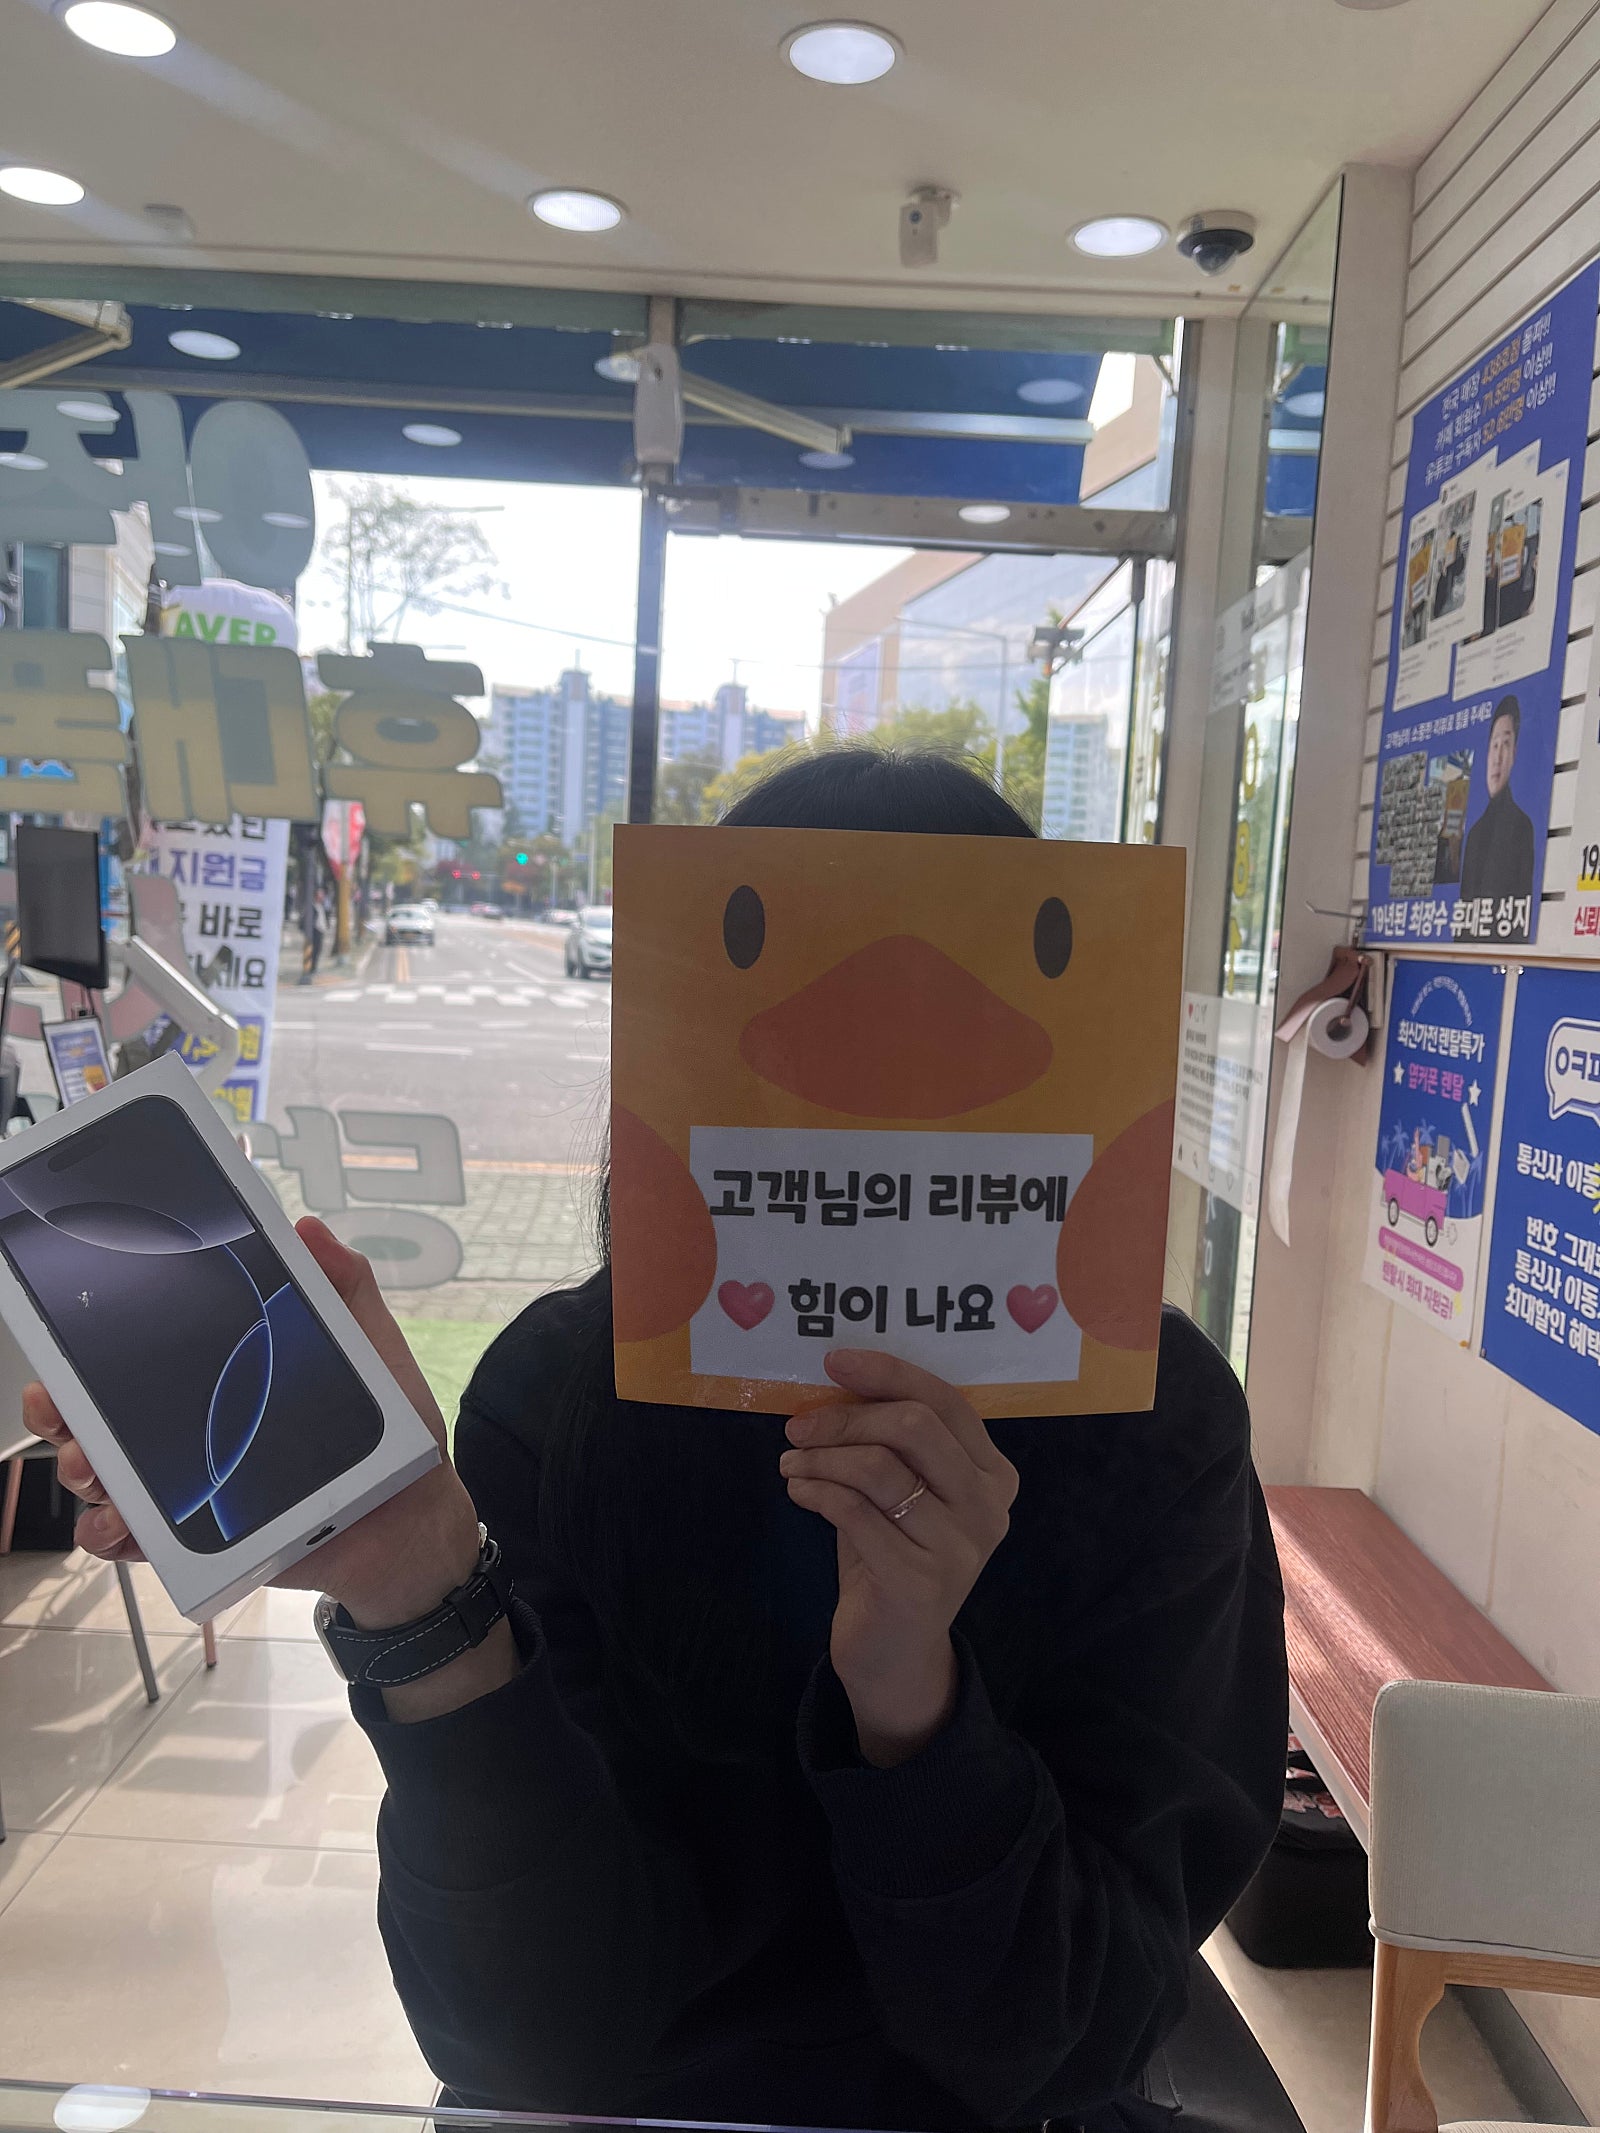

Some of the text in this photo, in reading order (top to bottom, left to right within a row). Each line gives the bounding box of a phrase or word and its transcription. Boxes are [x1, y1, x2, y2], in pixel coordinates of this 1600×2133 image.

[1523, 342, 1554, 380] 이상!!
[1526, 373, 1557, 410] 이상!!
[168, 847, 267, 893] 지원금
[1581, 844, 1600, 881] 19
[199, 902, 263, 940] 바로
[1371, 895, 1532, 938] 19년된 최장수 휴대폰 성지
[1441, 1070, 1465, 1102] 렌탈
[1516, 1142, 1563, 1186] 통신사
[710, 1169, 1069, 1227] 고객님의 리뷰에
[1526, 1216, 1560, 1257] 번호
[1514, 1248, 1563, 1300] 통신사
[1564, 1275, 1600, 1320] 이동
[787, 1278, 996, 1338] 힘이 나요
[1504, 1282, 1567, 1345] 최대할인
